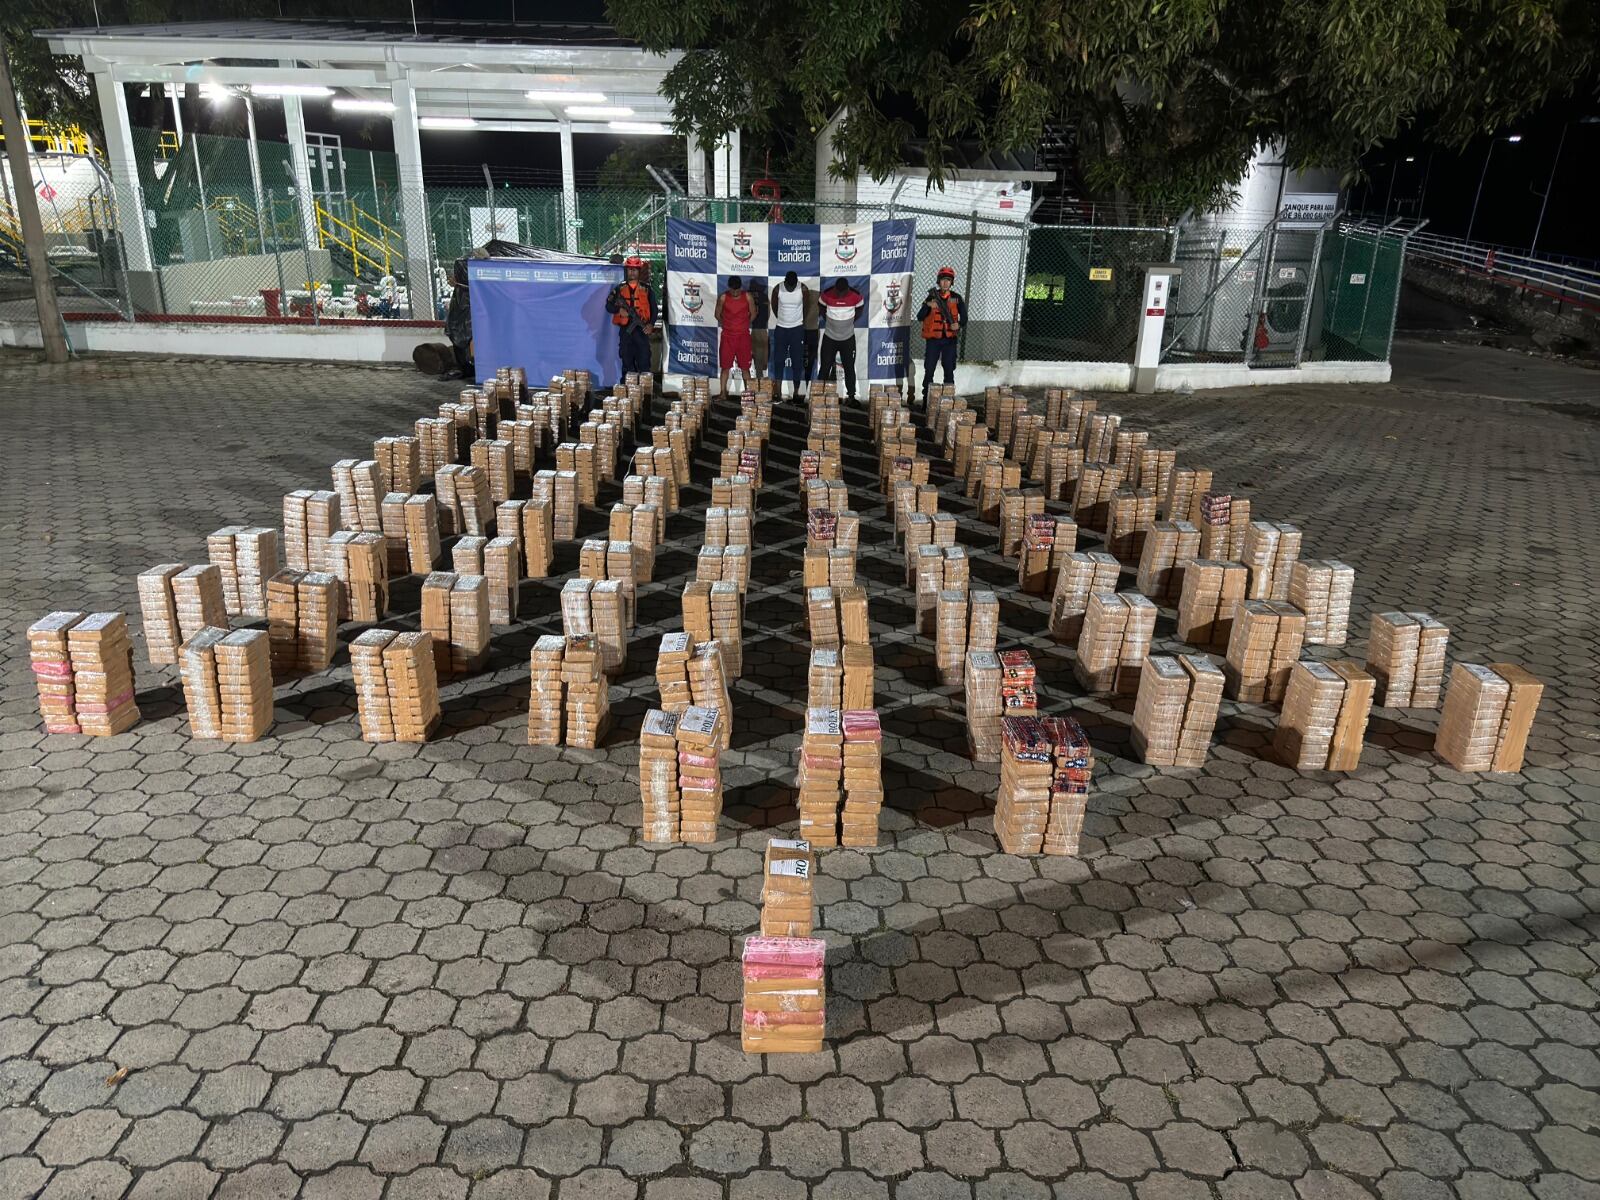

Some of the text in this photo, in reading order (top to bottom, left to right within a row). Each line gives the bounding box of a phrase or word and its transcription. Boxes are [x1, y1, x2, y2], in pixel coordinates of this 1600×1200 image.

[1285, 203, 1309, 211] TANQUE
[679, 232, 707, 242] Protegemos
[782, 238, 810, 246] Protegemos
[675, 244, 707, 259] bandera
[778, 249, 811, 263] bandera
[881, 247, 907, 260] bandera
[677, 350, 709, 364] bandera
[701, 708, 718, 733] ROLEX
[828, 709, 839, 734] ROLEX
